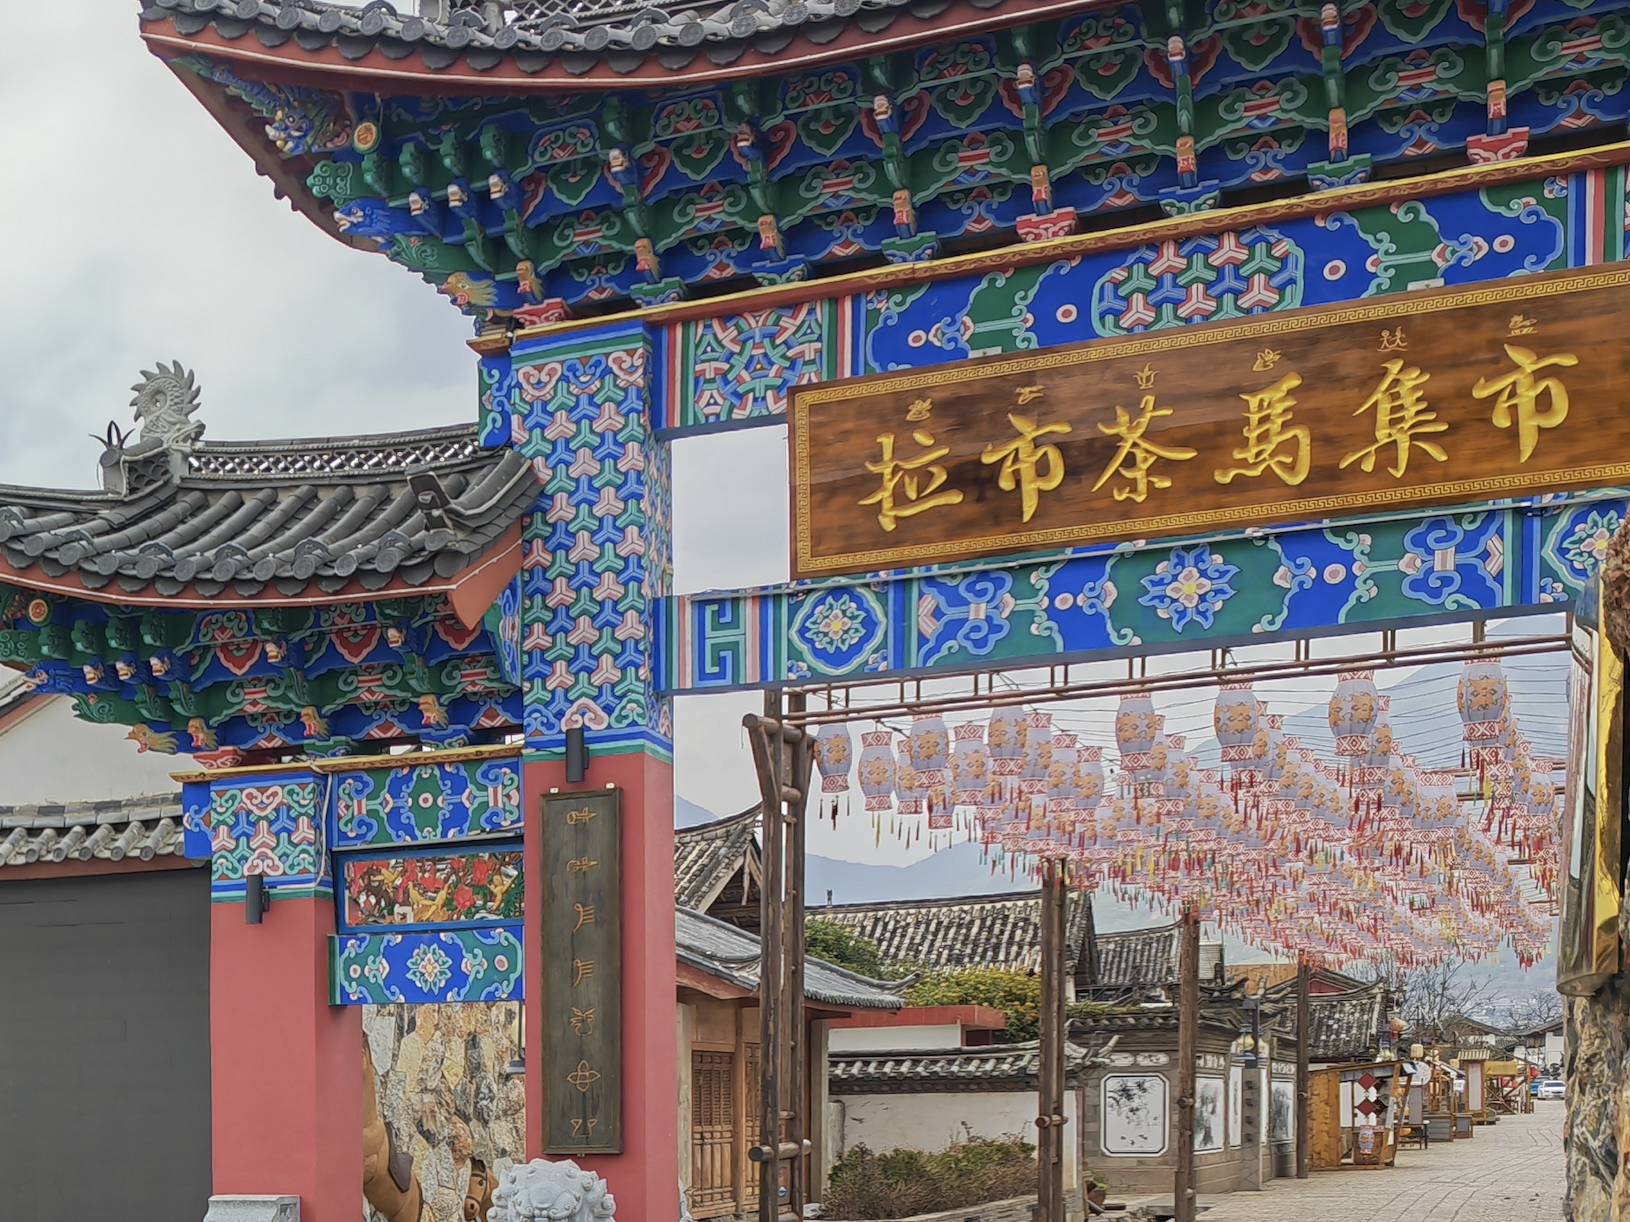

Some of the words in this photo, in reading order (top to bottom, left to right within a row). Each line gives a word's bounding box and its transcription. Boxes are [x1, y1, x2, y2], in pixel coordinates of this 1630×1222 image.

[858, 343, 1581, 532] 拉市茶馬集市
